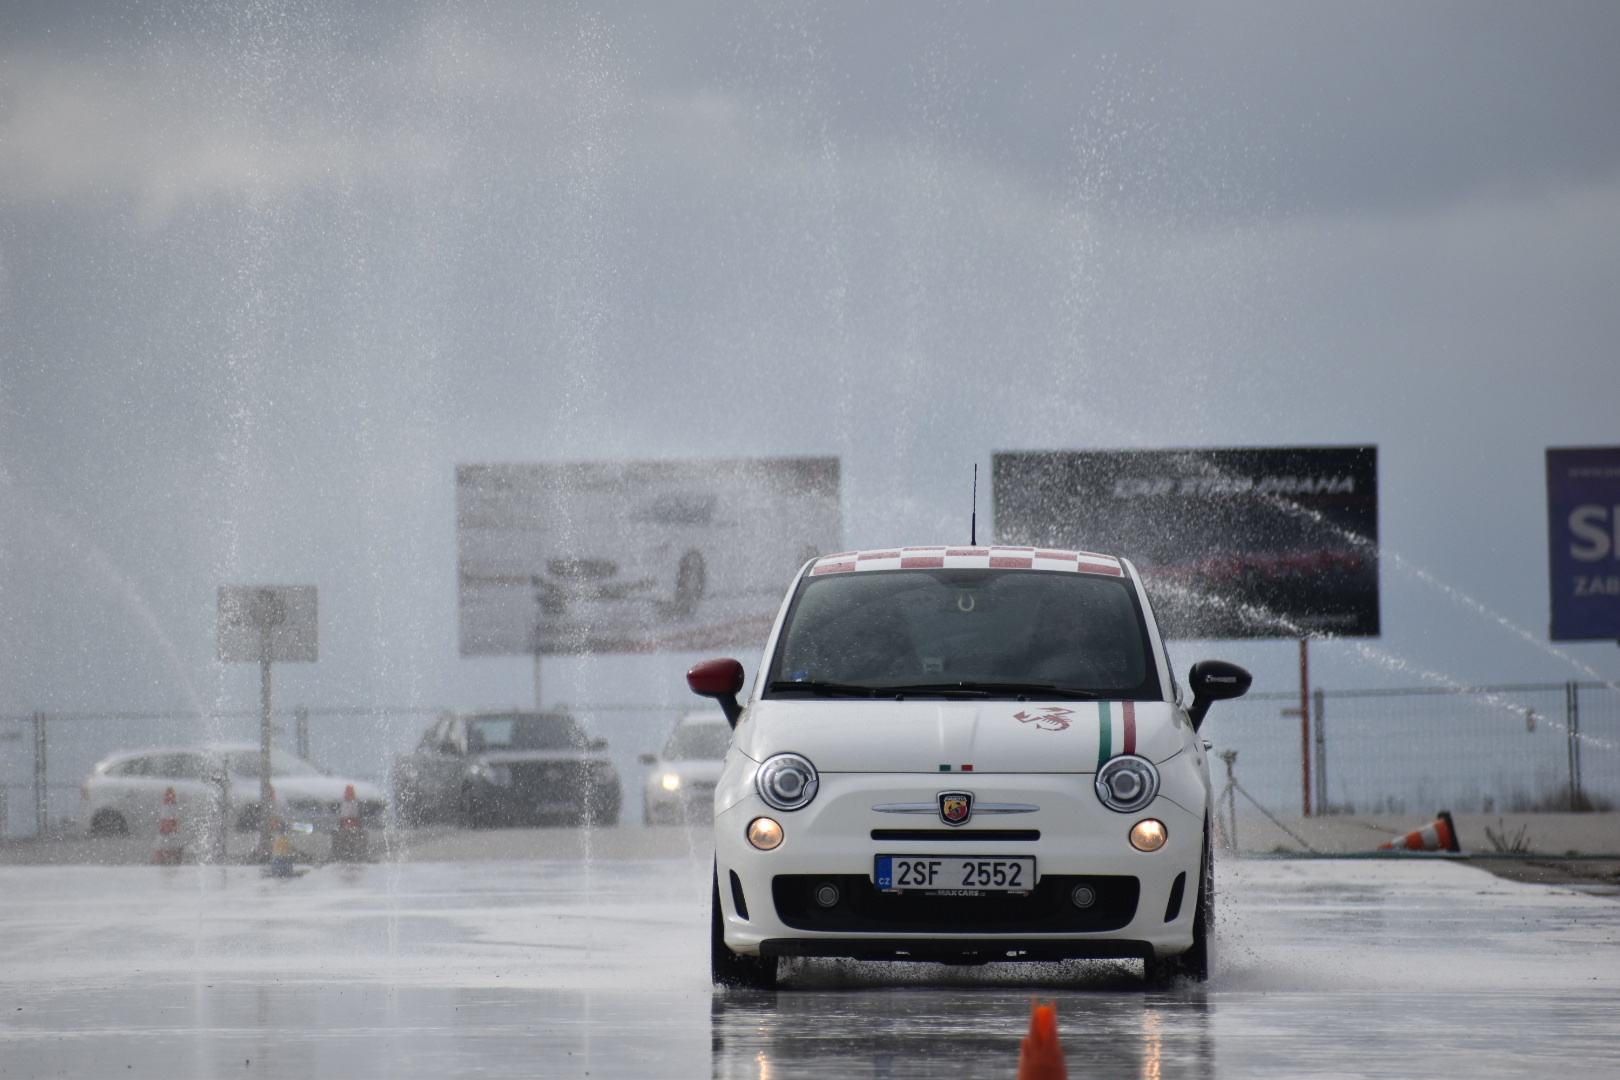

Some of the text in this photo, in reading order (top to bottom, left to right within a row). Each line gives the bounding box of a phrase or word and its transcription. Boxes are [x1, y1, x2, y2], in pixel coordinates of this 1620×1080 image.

[878, 877, 890, 885] CZ
[898, 861, 1022, 887] 2SF 2552
